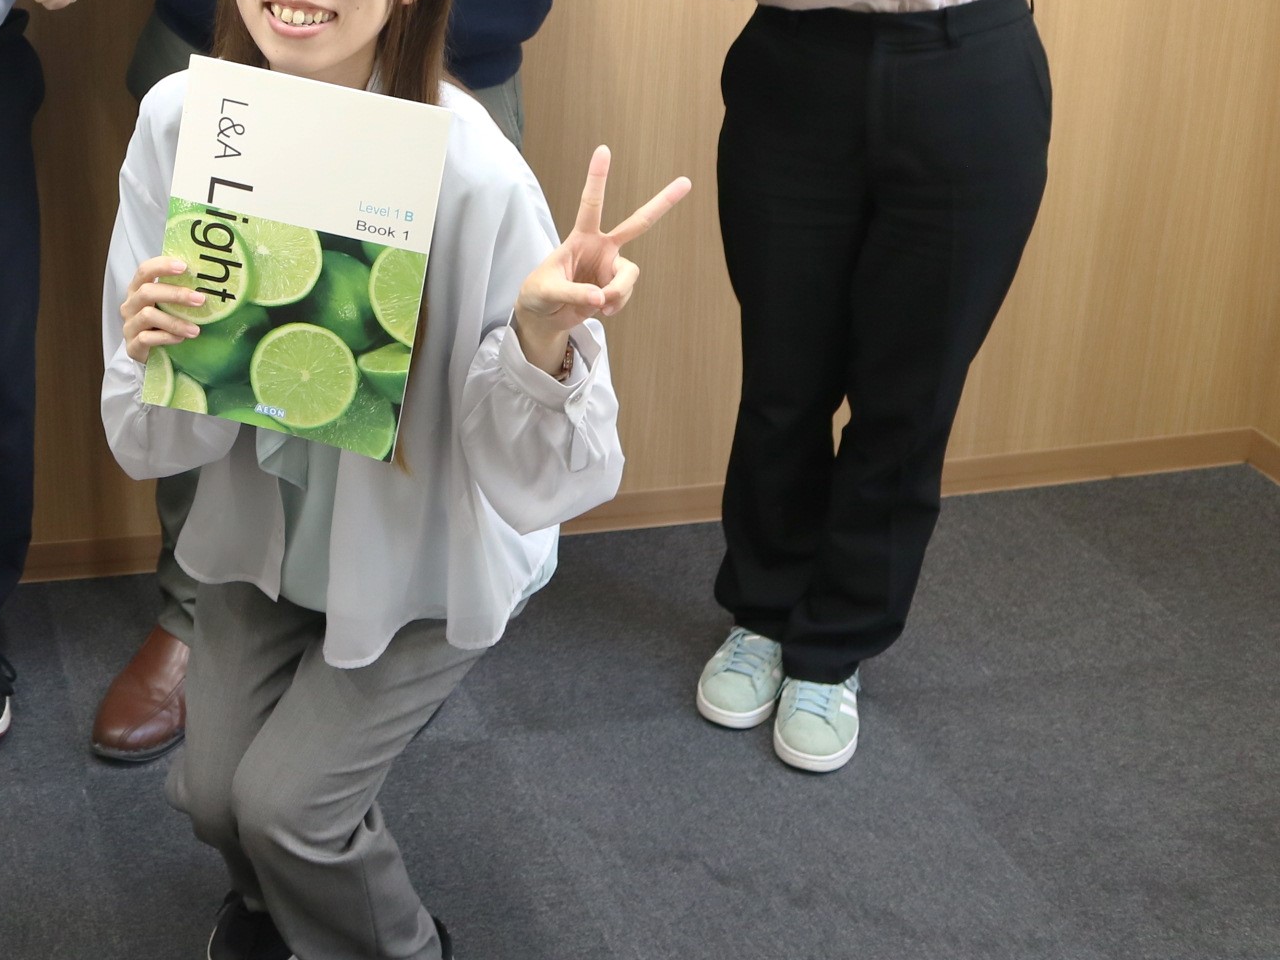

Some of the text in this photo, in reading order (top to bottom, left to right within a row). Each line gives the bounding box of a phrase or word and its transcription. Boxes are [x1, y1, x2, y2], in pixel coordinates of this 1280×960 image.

[190, 97, 254, 303] L&A Light
[358, 200, 413, 222] Level 1 B
[356, 220, 409, 241] Book 1
[255, 404, 286, 418] AEON
